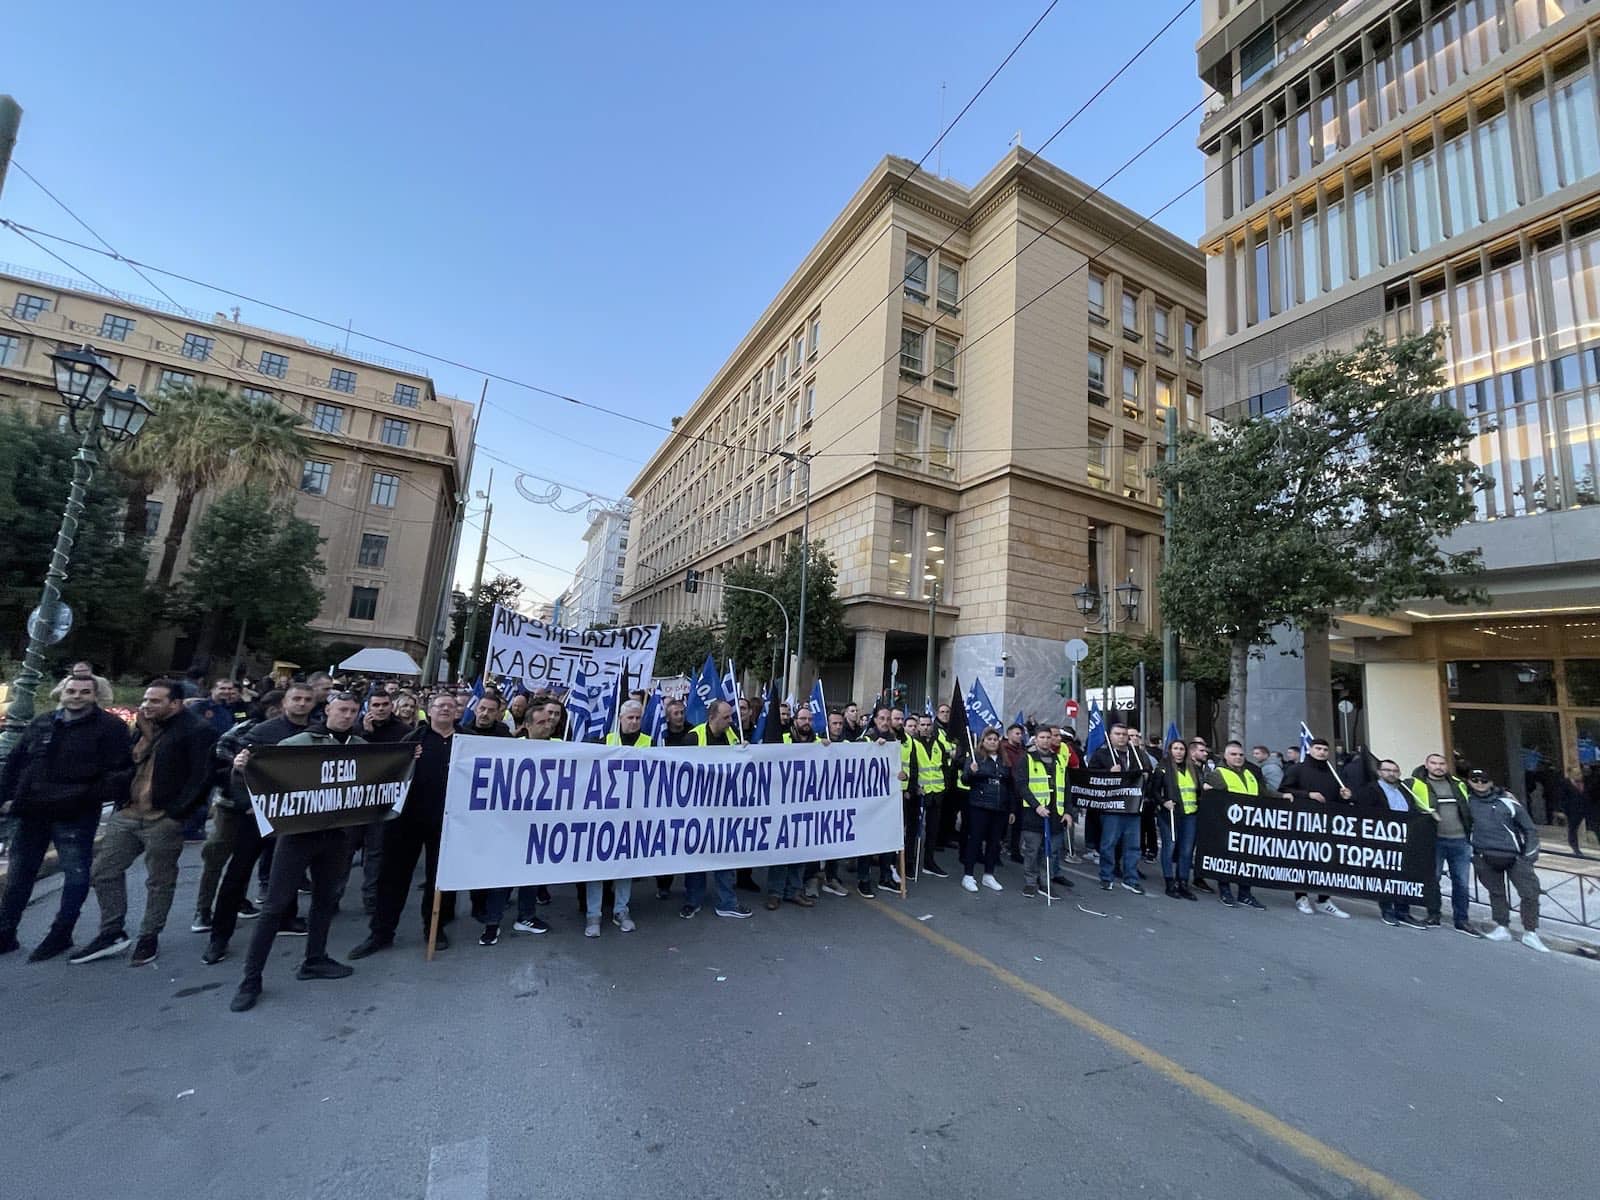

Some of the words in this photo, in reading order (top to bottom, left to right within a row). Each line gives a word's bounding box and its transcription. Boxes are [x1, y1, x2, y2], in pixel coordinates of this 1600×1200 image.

[321, 760, 335, 784] ΩΣ
[337, 759, 358, 783] ΕΔΩ
[469, 757, 578, 811] ΕΝΩΣΗ
[583, 759, 773, 810] ΑΣΤΥΝΟΜΙΚΩΝ
[778, 756, 891, 805] ΥΠΑΛΛΗΛΩΝ
[268, 792, 279, 818] Η
[279, 787, 343, 817] ΑΣΤΥΝΟΜΙΑ
[343, 785, 365, 810] ΑΠΟ
[365, 784, 376, 806] ΤΑ
[1076, 798, 1090, 808] ΠΟΥ
[525, 815, 773, 865] ΝΟΤΙΟΑΝΑΤΟΛΙΚΗΣ
[774, 808, 857, 850] ΑΤΤΙΚΗΣ
[1226, 803, 1293, 830] ΦΤΑΝΕΙ
[1295, 811, 1328, 834] ΠΙΑ!
[1331, 815, 1358, 838] ΩΣ
[1361, 818, 1408, 844] ΕΔΩ!
[1227, 830, 1332, 863] ΕΠΙΚΙΝΔΥΝΟ
[1336, 843, 1403, 872] ΤΩΡΑ!!!
[1202, 855, 1238, 875] ΕΝΩΣΗ
[1237, 861, 1307, 884] ΑΣΤΥΝΟΜΙΚΩΝ
[1306, 870, 1364, 892] ΥΠΑΛΛΗΛΩΝ
[1365, 877, 1384, 894] Ν/Α
[1383, 879, 1425, 898] ΑΤΤΙΚΗΣ
